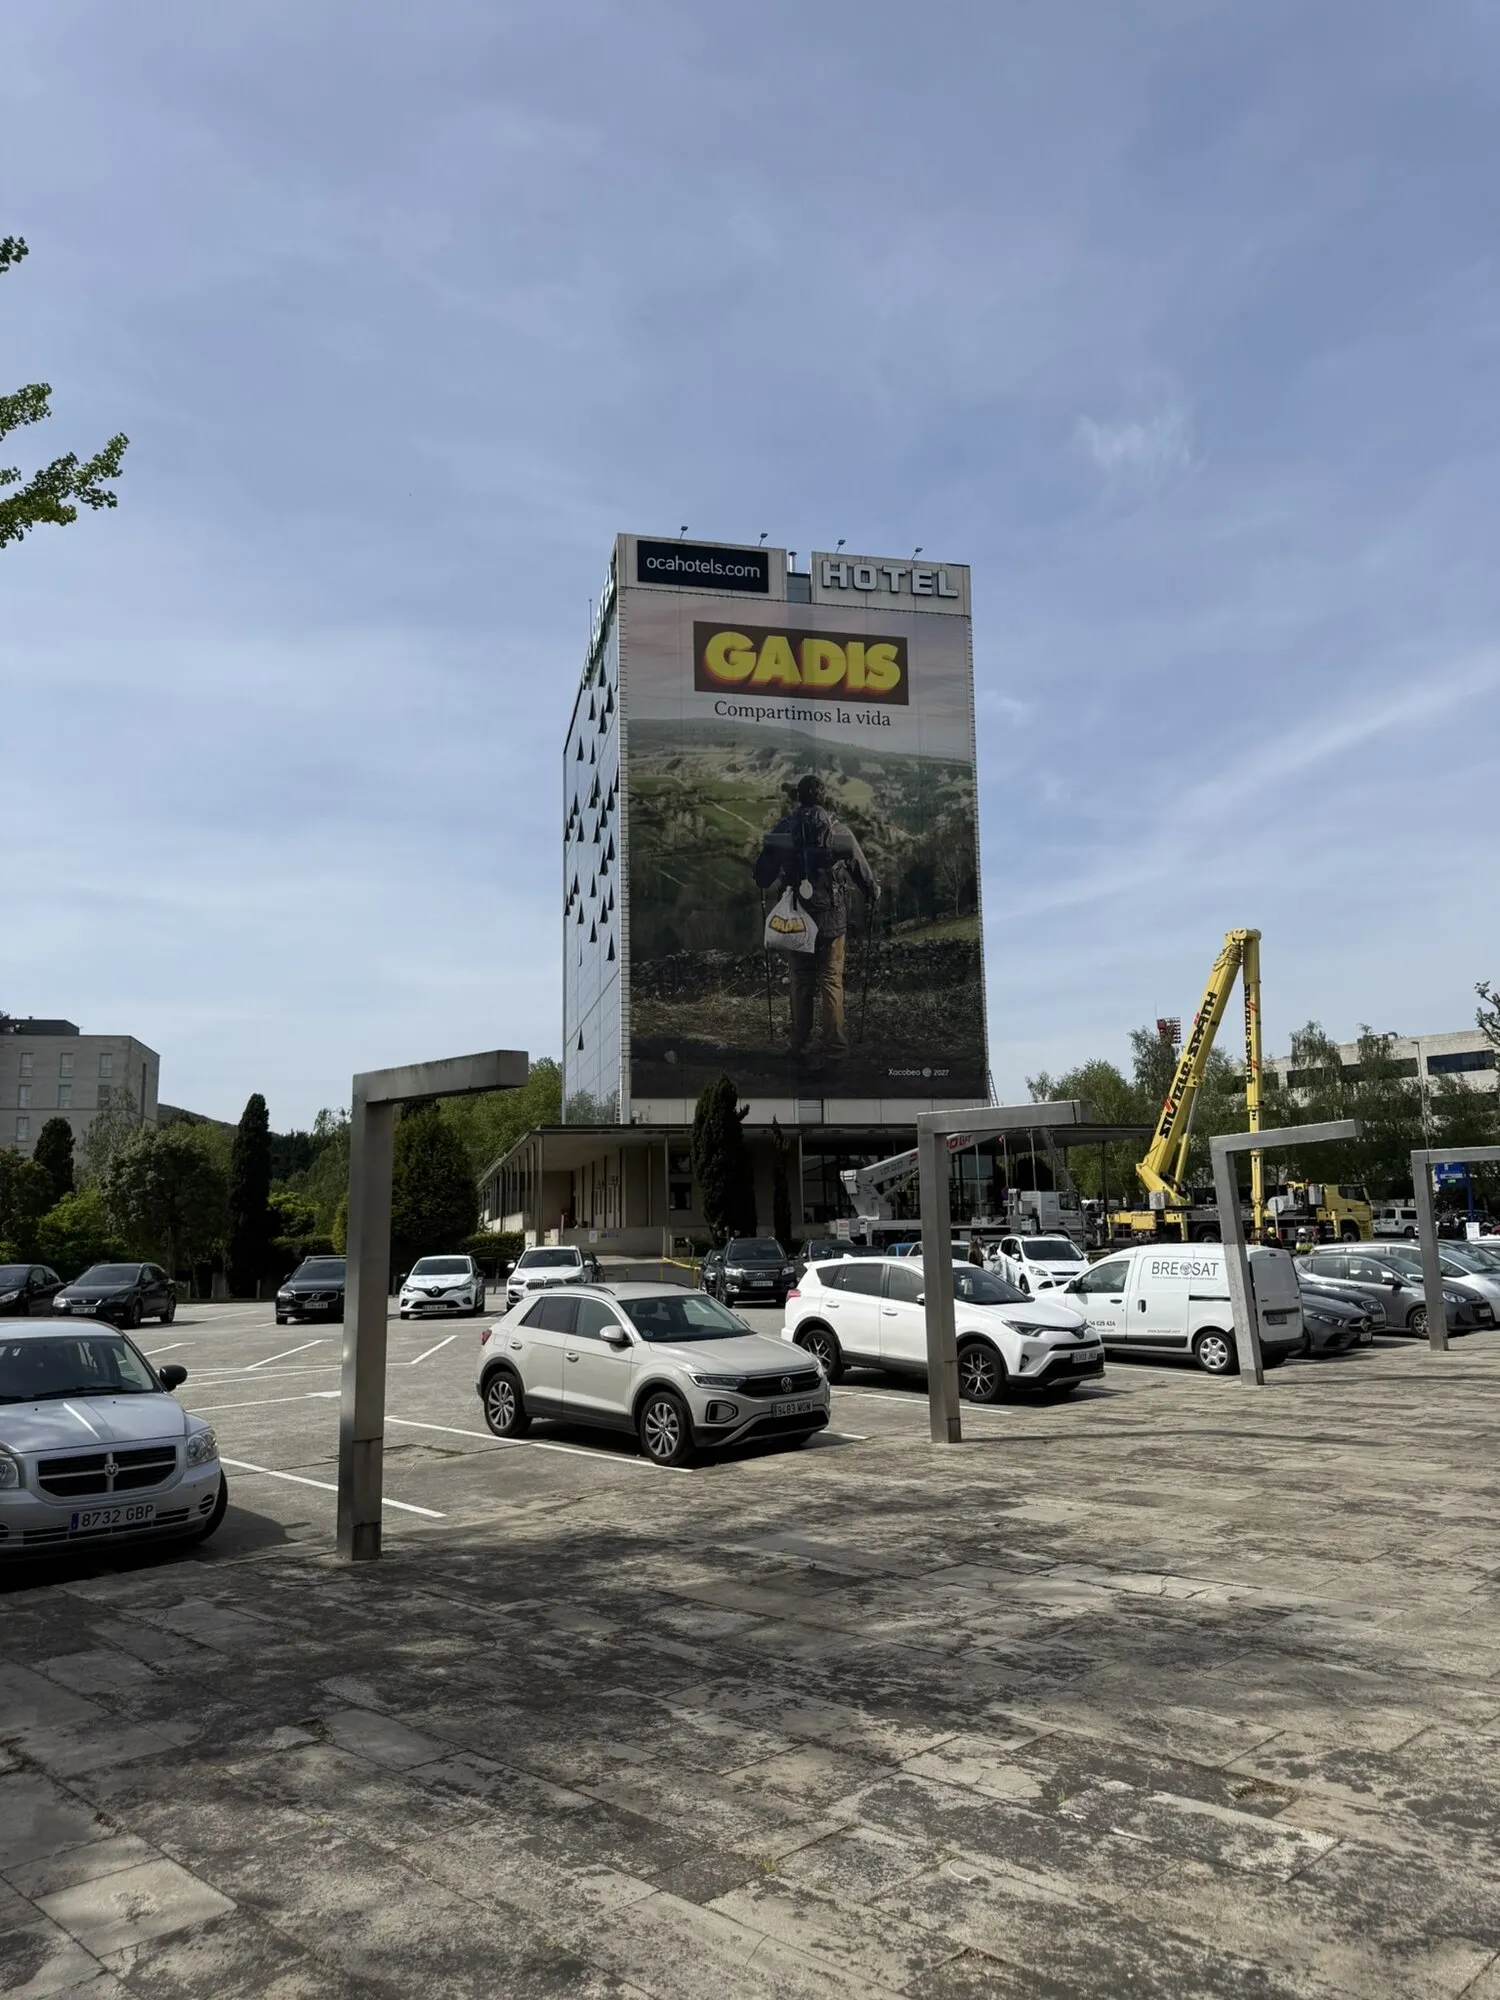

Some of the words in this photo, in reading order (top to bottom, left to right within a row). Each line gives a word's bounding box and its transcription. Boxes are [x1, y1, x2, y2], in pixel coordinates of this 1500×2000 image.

[646, 555, 760, 578] ocahotels.com
[822, 560, 959, 597] HOTEL
[705, 631, 901, 695] GADIS
[714, 700, 831, 722] Compartimos
[837, 708, 851, 724] la
[855, 710, 891, 726] vida
[81, 1509, 120, 1527] 8732
[126, 1504, 153, 1521] GBP
